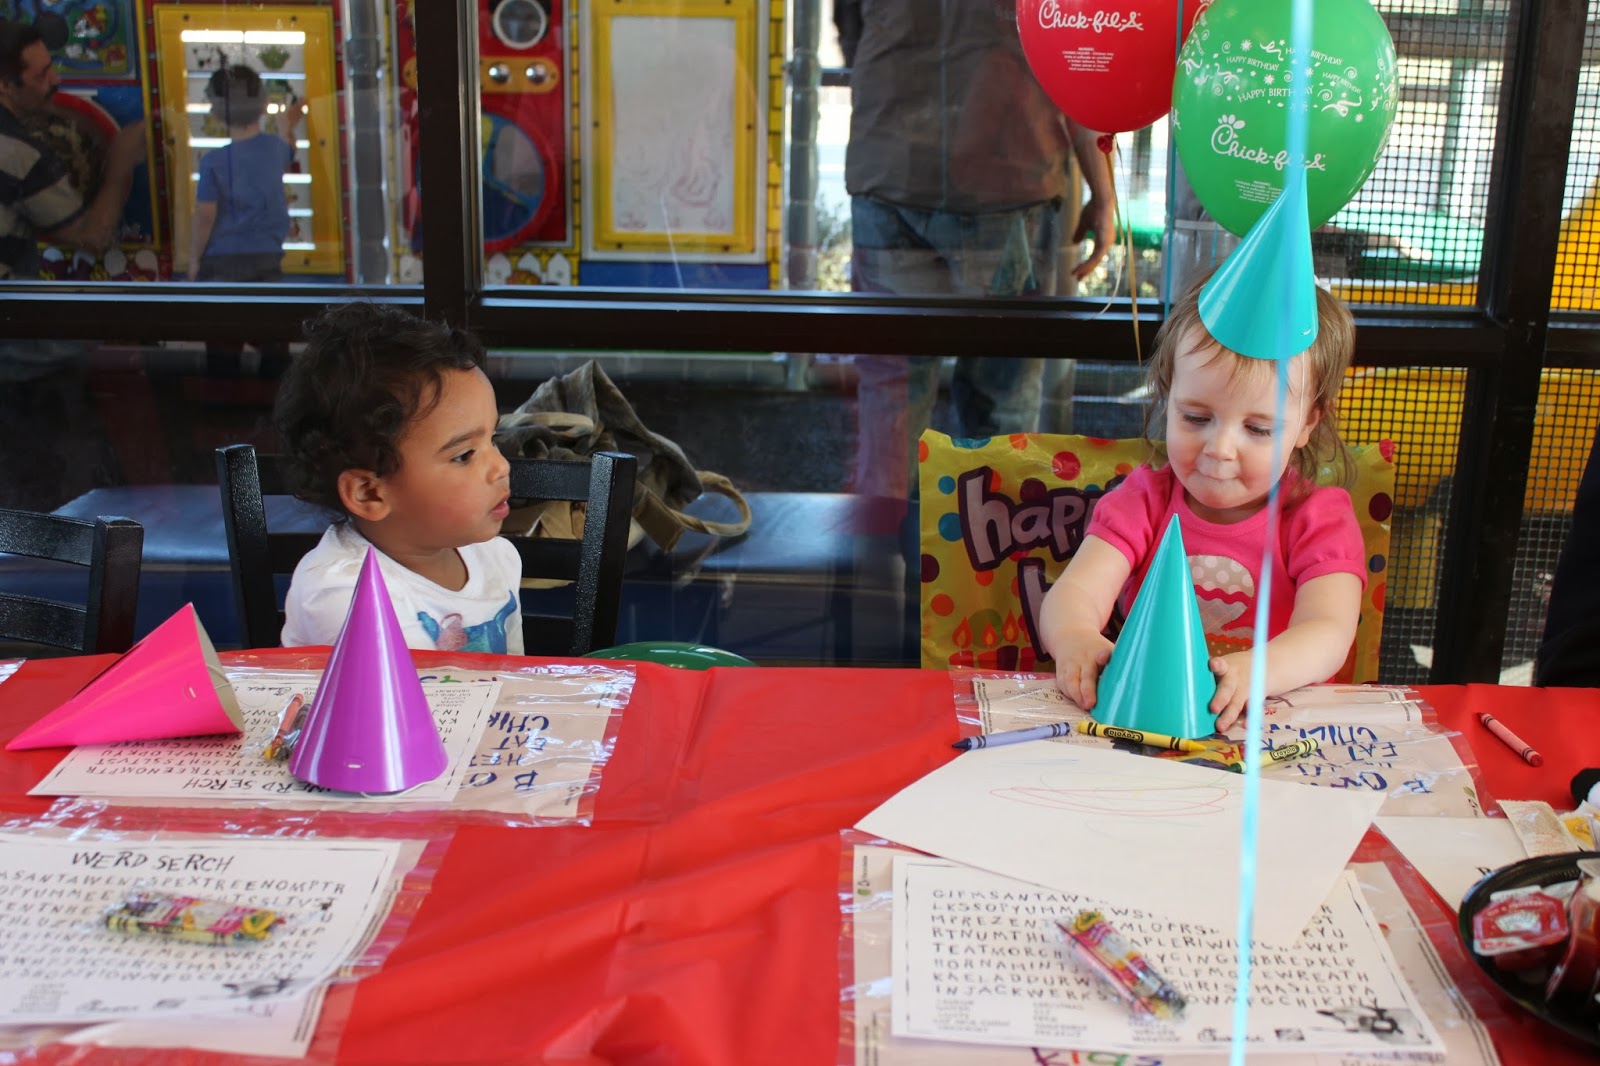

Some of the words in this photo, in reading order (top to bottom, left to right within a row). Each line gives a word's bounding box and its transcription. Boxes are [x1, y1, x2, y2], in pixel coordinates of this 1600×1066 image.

[1038, 0, 1144, 33] Chick-fil-A
[1226, 55, 1247, 64] HAPPY
[1247, 58, 1280, 72] BIRTHDAY
[1285, 47, 1310, 56] HAY
[1310, 50, 1343, 66] BIRTHDAY
[1237, 88, 1267, 103] HAPPY
[1268, 86, 1315, 97] BIRTHAY
[1211, 123, 1326, 171] Chick-f-A
[1108, 730, 1143, 742] Crayola
[1272, 746, 1298, 759] Crayola
[181, 778, 252, 791] SERCH
[72, 850, 148, 869] WERD
[156, 852, 235, 873] SERCH
